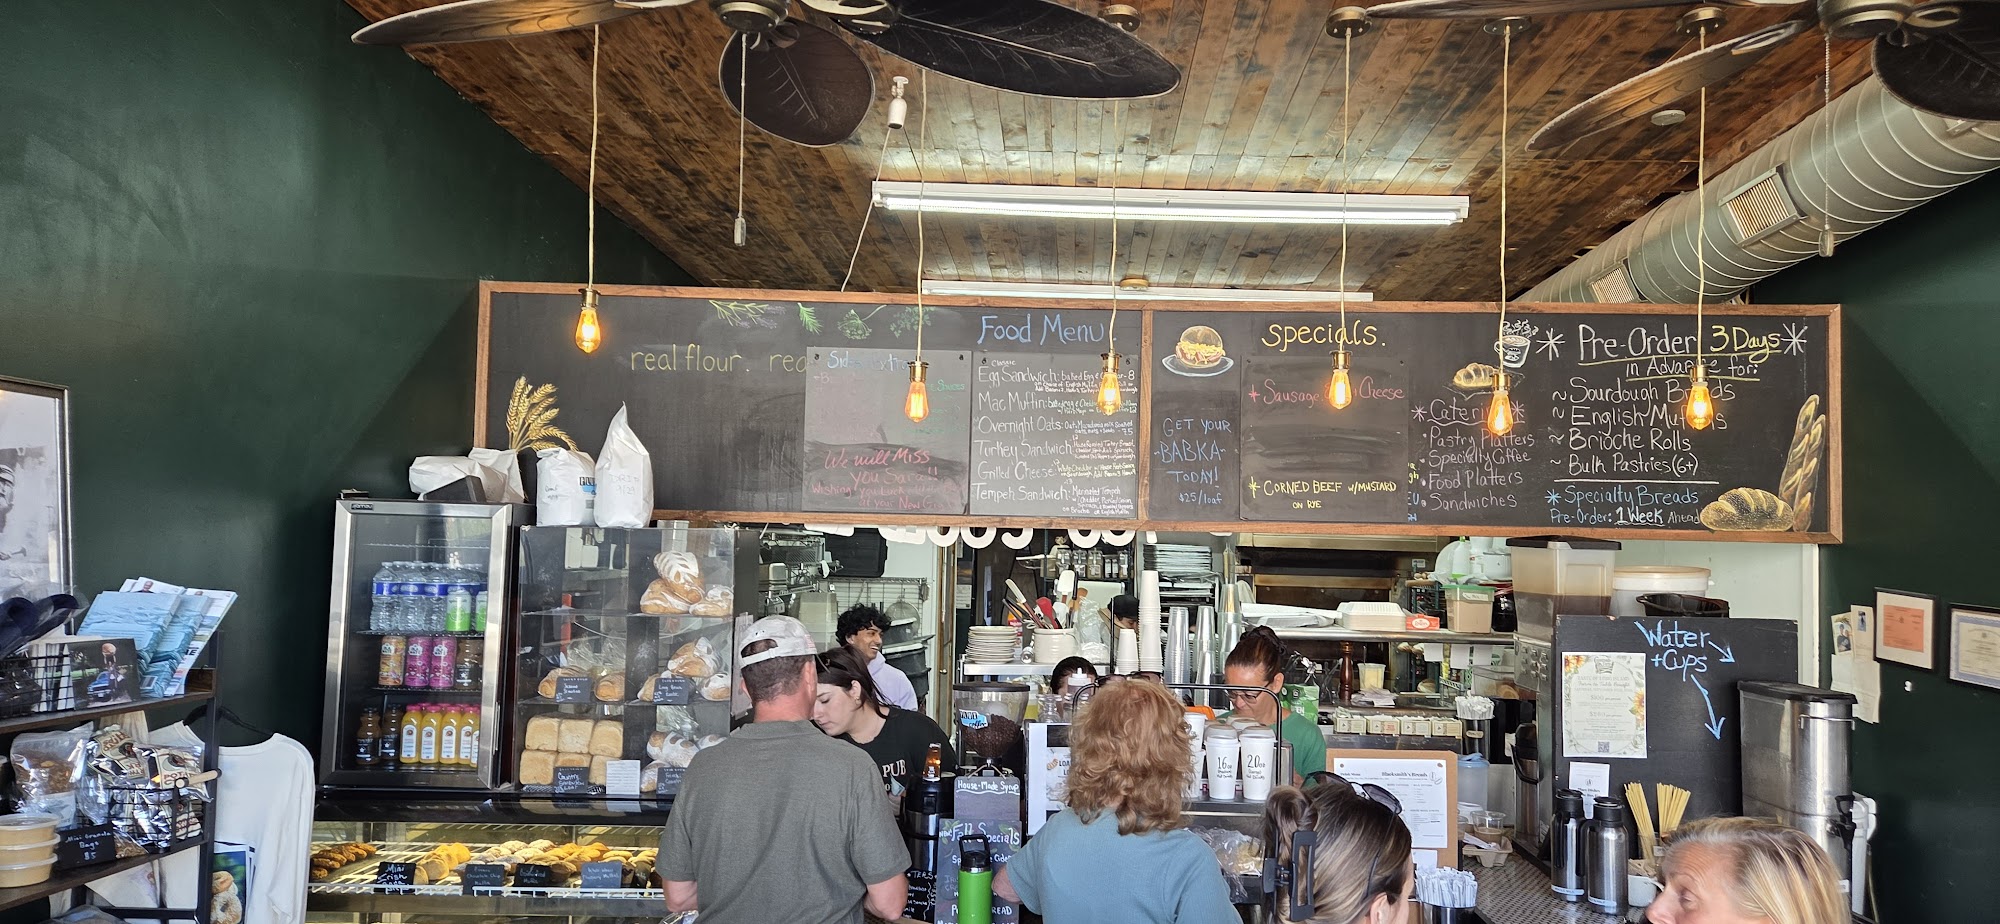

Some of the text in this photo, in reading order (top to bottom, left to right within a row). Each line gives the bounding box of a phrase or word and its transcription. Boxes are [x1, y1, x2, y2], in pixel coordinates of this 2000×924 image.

[977, 313, 1031, 345] Food
[1579, 323, 1782, 363] Pre-Order 3 Days
[630, 345, 677, 373] real
[1626, 363, 1640, 377] in
[978, 366, 1000, 388] Egg
[1359, 376, 1405, 400] Cheese
[979, 391, 1006, 412] Mac
[1570, 378, 1736, 414] Sourdough Brds
[1430, 397, 1489, 421] Cateri
[978, 416, 1034, 440] Overnight
[1163, 417, 1231, 437] GET YOUR
[1571, 405, 1644, 436] English
[1430, 426, 1534, 449] Pastry Platters
[1569, 428, 1691, 450] Brioche Rolls
[824, 448, 848, 469] We
[974, 440, 1017, 465] Turkey
[1429, 447, 1531, 472] Specialty Coffee
[977, 461, 1009, 480] Grilled
[1569, 453, 1606, 476] Bulk
[850, 471, 880, 491] you
[1312, 480, 1342, 493] BEEF
[1429, 470, 1461, 490] Food
[1465, 467, 1523, 488] Platters
[972, 483, 1015, 503] Tempeh
[1430, 490, 1517, 511] Sandwiches
[1565, 484, 1699, 512] Specialty Breads
[1627, 507, 1664, 524] Week
[1668, 510, 1699, 524] Ahead
[1634, 620, 1711, 648] Water
[882, 760, 906, 778] PUB
[957, 780, 1019, 794] House-Made Syrup
[991, 904, 1012, 915] READ
